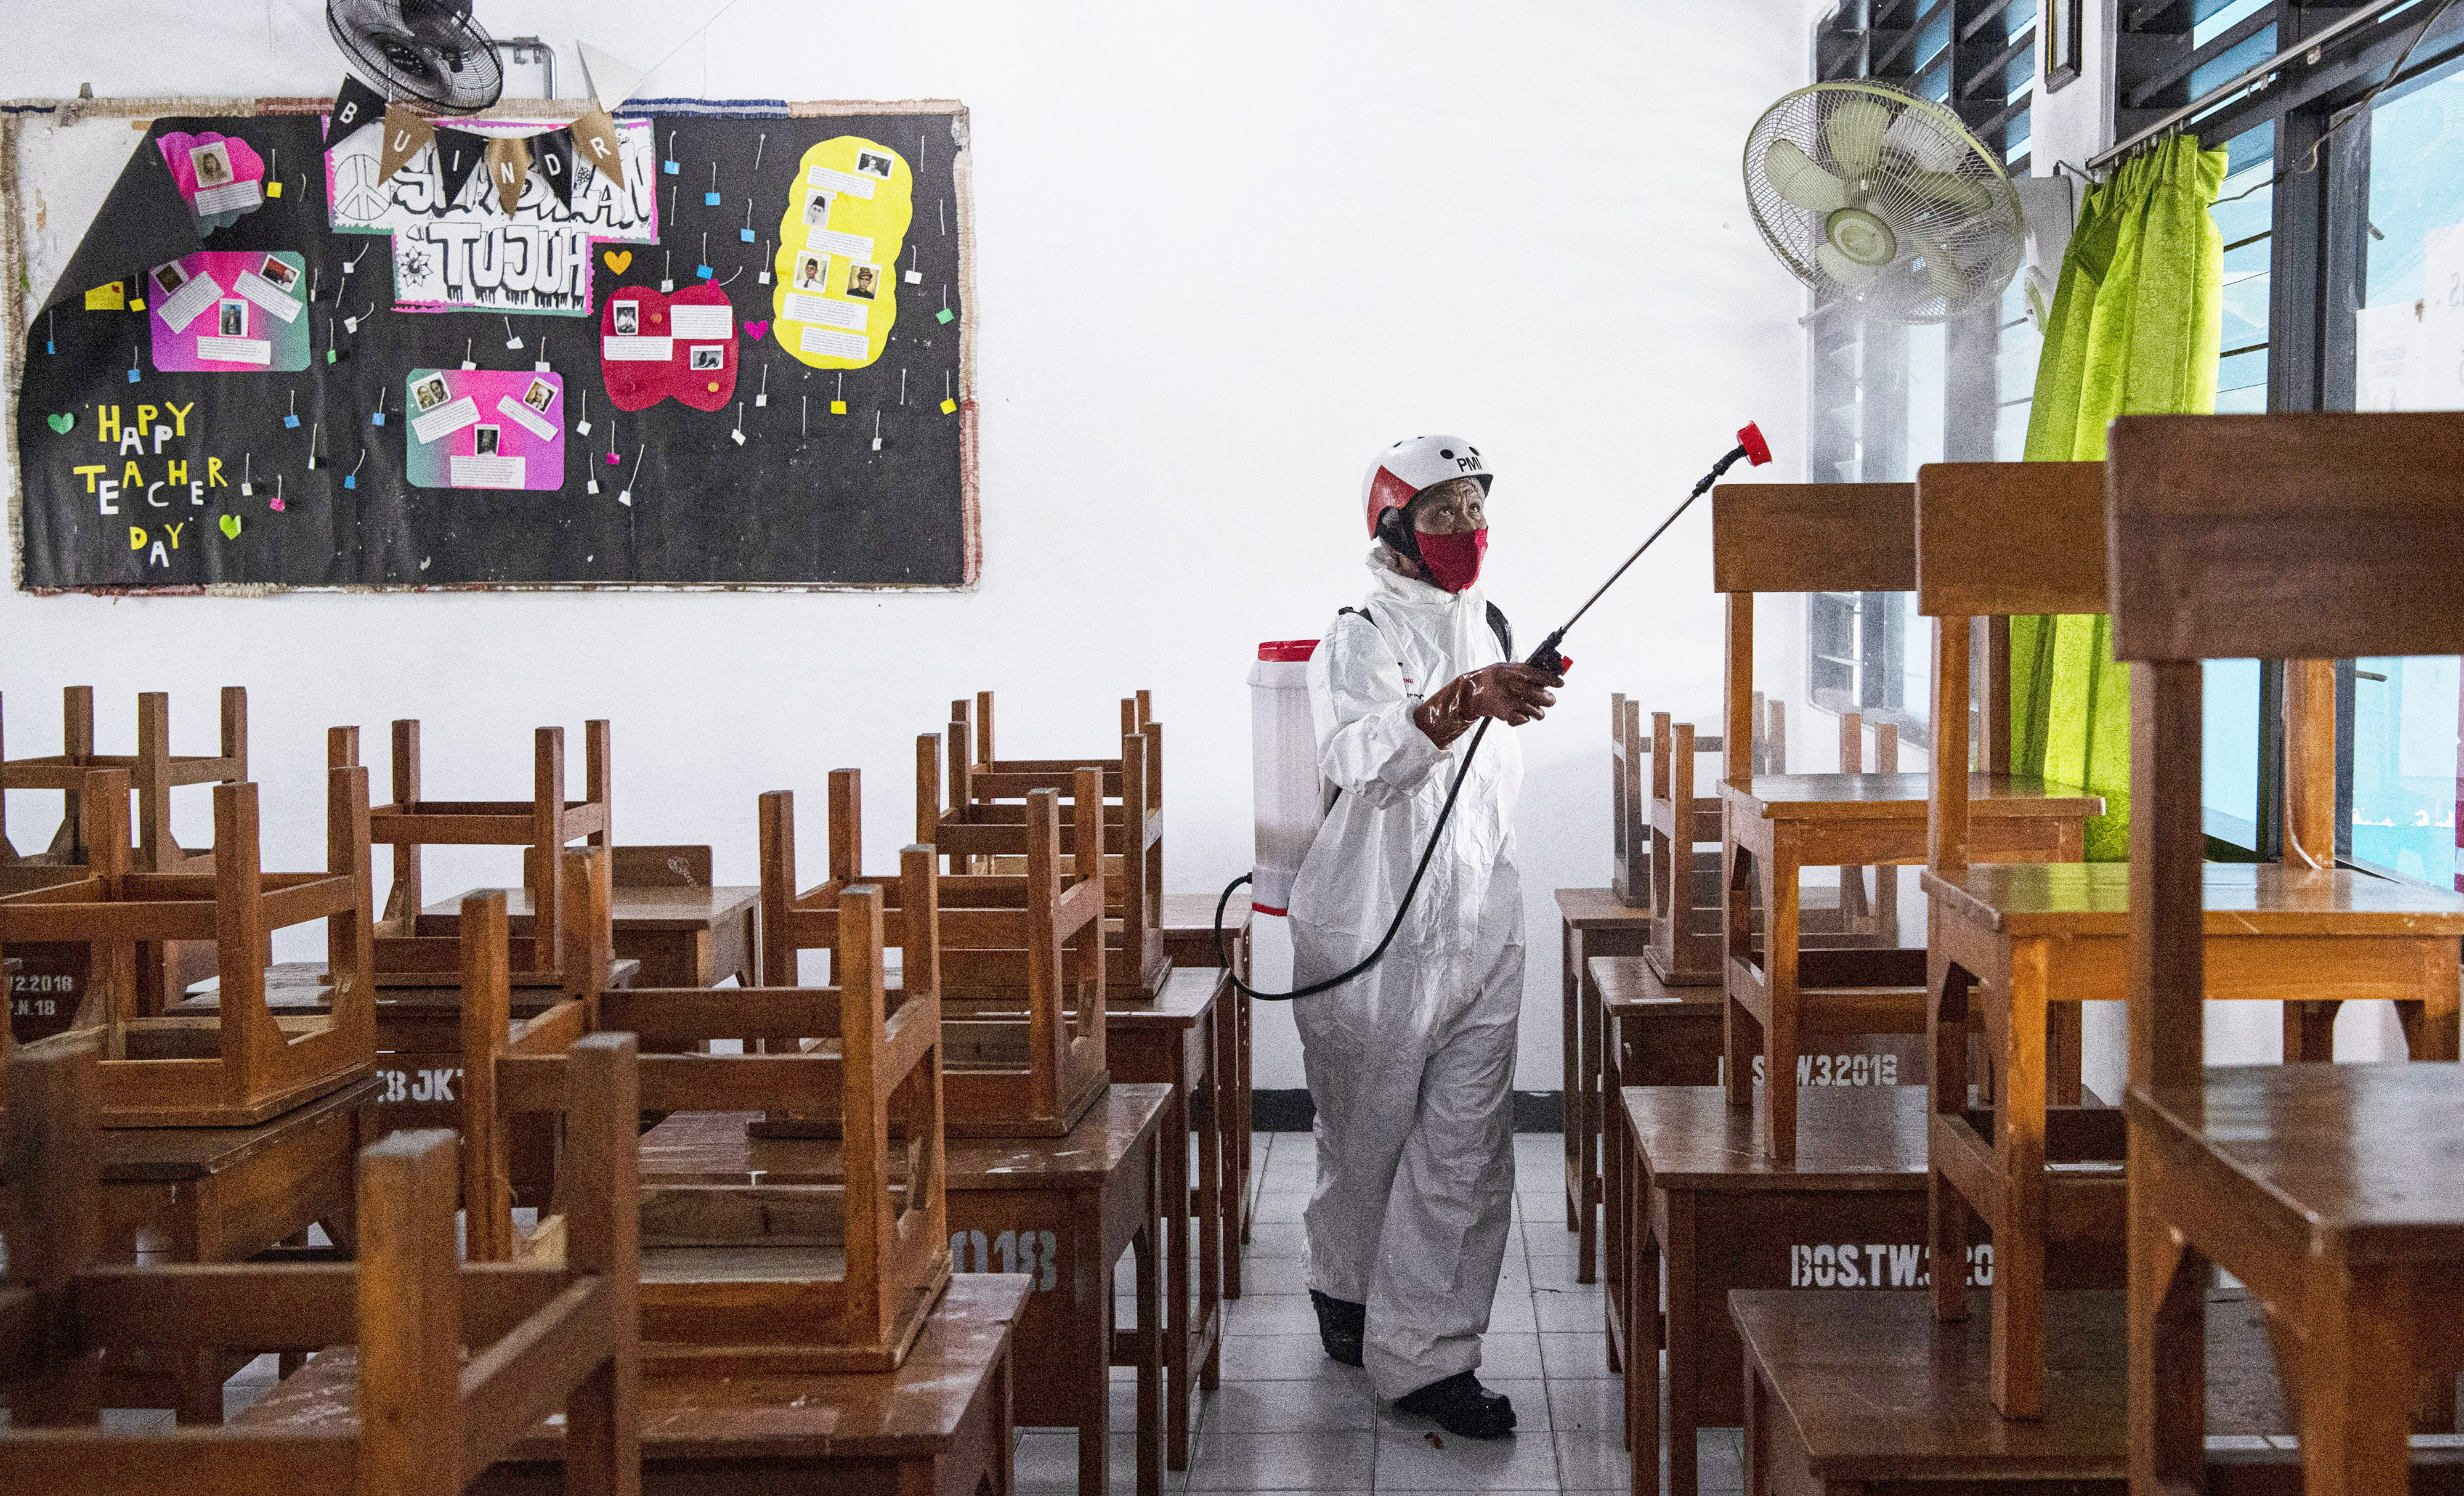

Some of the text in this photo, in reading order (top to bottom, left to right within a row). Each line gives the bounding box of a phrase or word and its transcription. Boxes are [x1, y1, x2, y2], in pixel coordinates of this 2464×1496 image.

[426, 222, 588, 306] TUJUH
[97, 401, 195, 456] HAPPY
[73, 456, 229, 515] TEACHER
[1456, 456, 1483, 473] PMI
[129, 521, 185, 568] DAY
